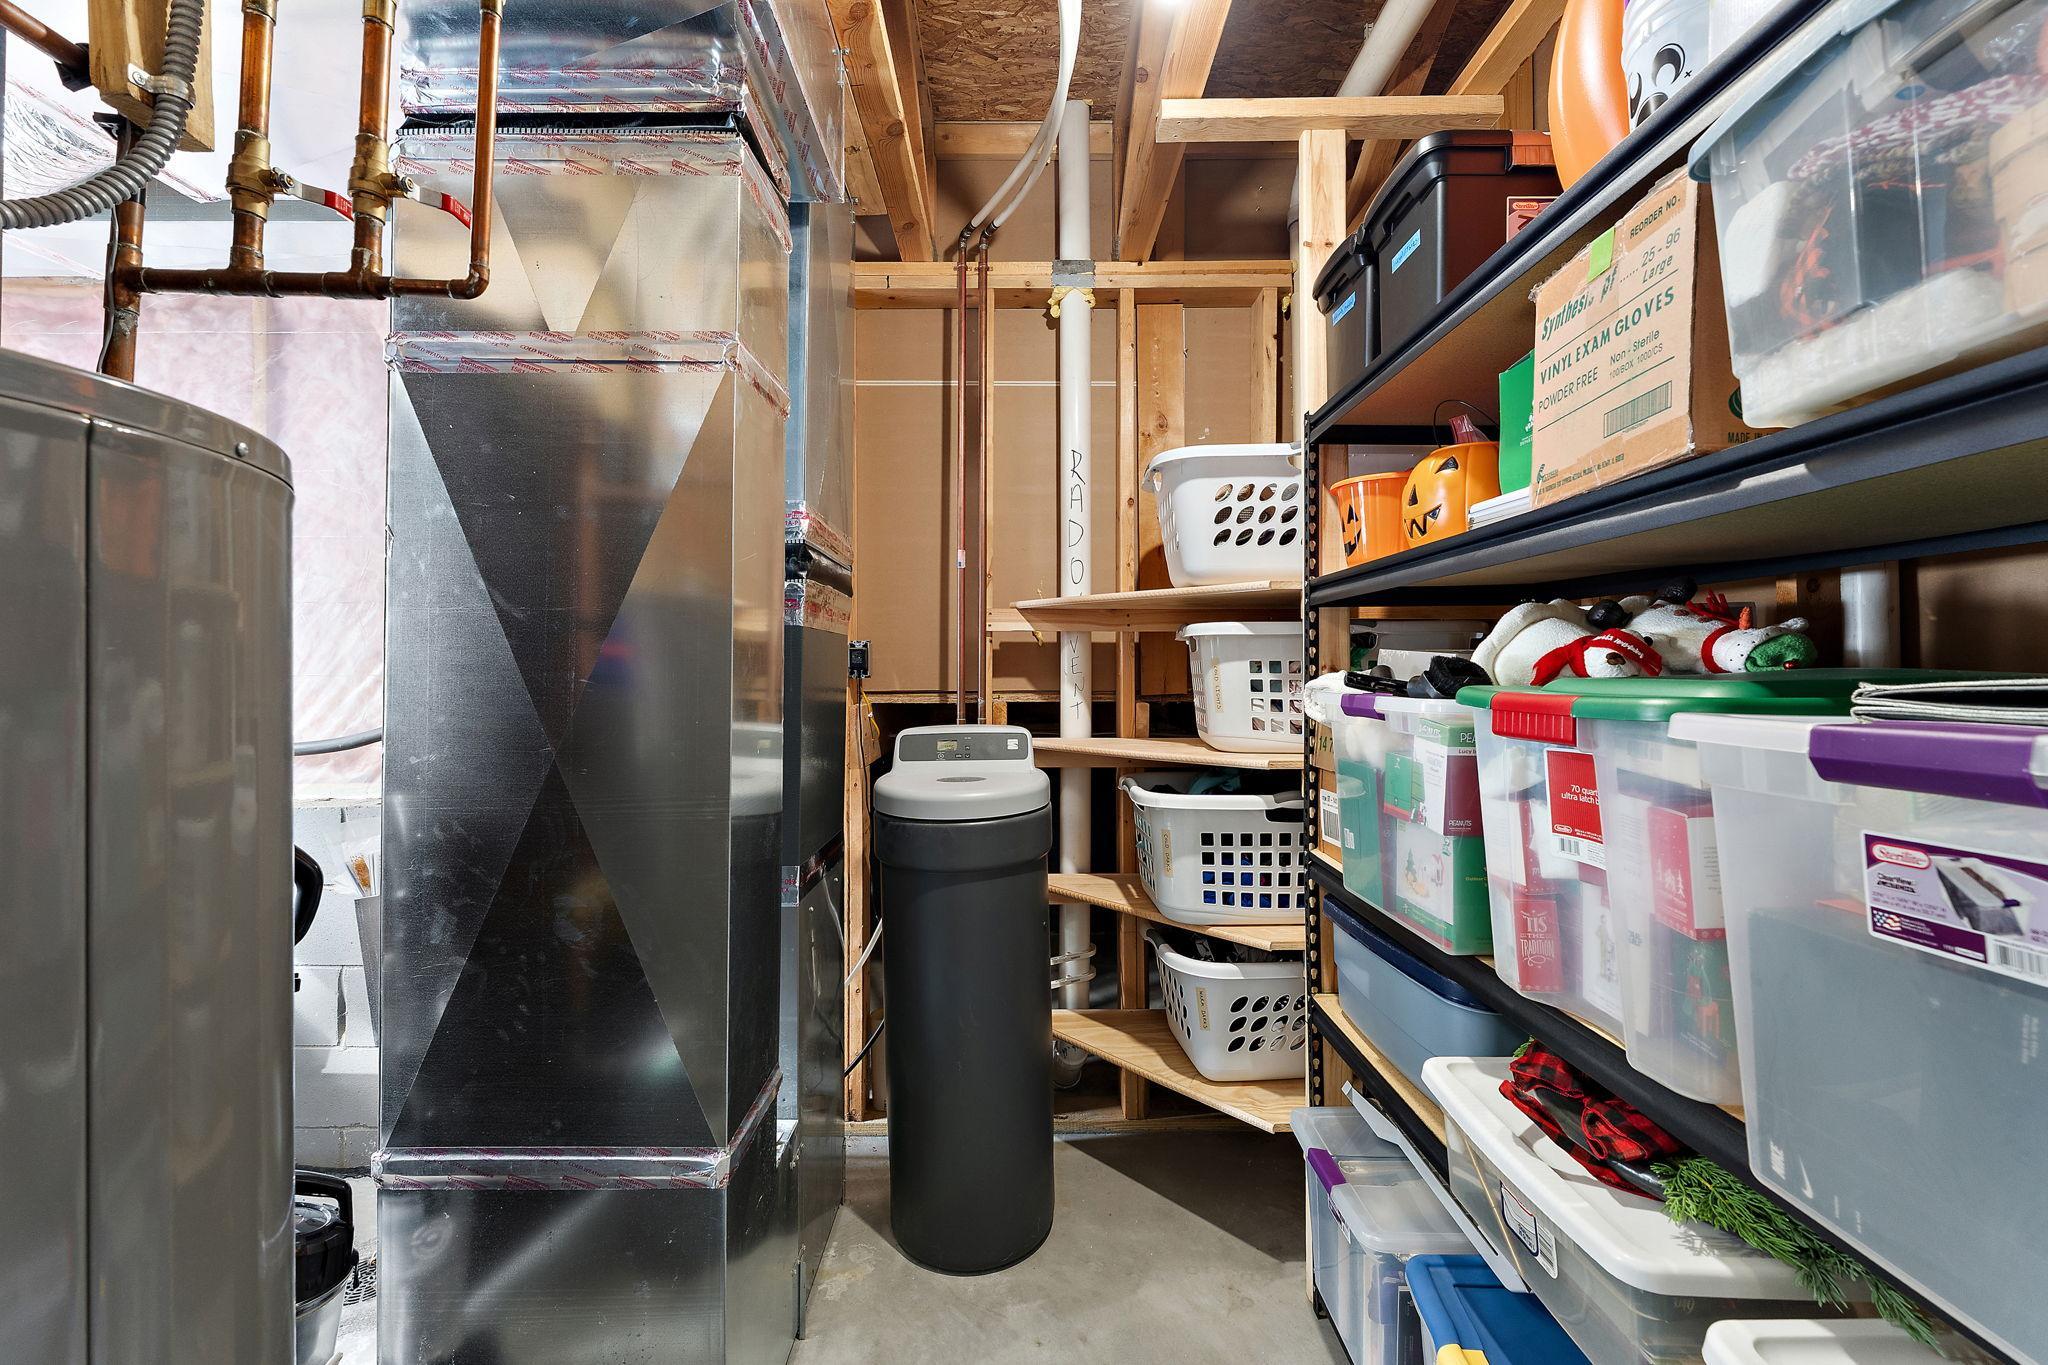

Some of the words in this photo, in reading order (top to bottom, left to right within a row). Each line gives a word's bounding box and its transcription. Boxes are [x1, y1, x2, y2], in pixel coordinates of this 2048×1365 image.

[1630, 206, 1663, 239] REORDER
[1642, 255, 1673, 283] Large
[1540, 355, 1572, 385] VINYL
[1575, 327, 1611, 363] EXAM
[1614, 285, 1675, 337] GLOVES
[1538, 382, 1575, 414] POWDER
[1576, 366, 1599, 391] FREE
[1728, 431, 1750, 444] MADE
[1068, 449, 1086, 596] RADO
[1069, 635, 1085, 720] VENT
[1561, 792, 1578, 801] ultra
[1579, 794, 1595, 804] latch
[1570, 785, 1581, 793] 70
[1520, 939, 1555, 959] TRADITION
